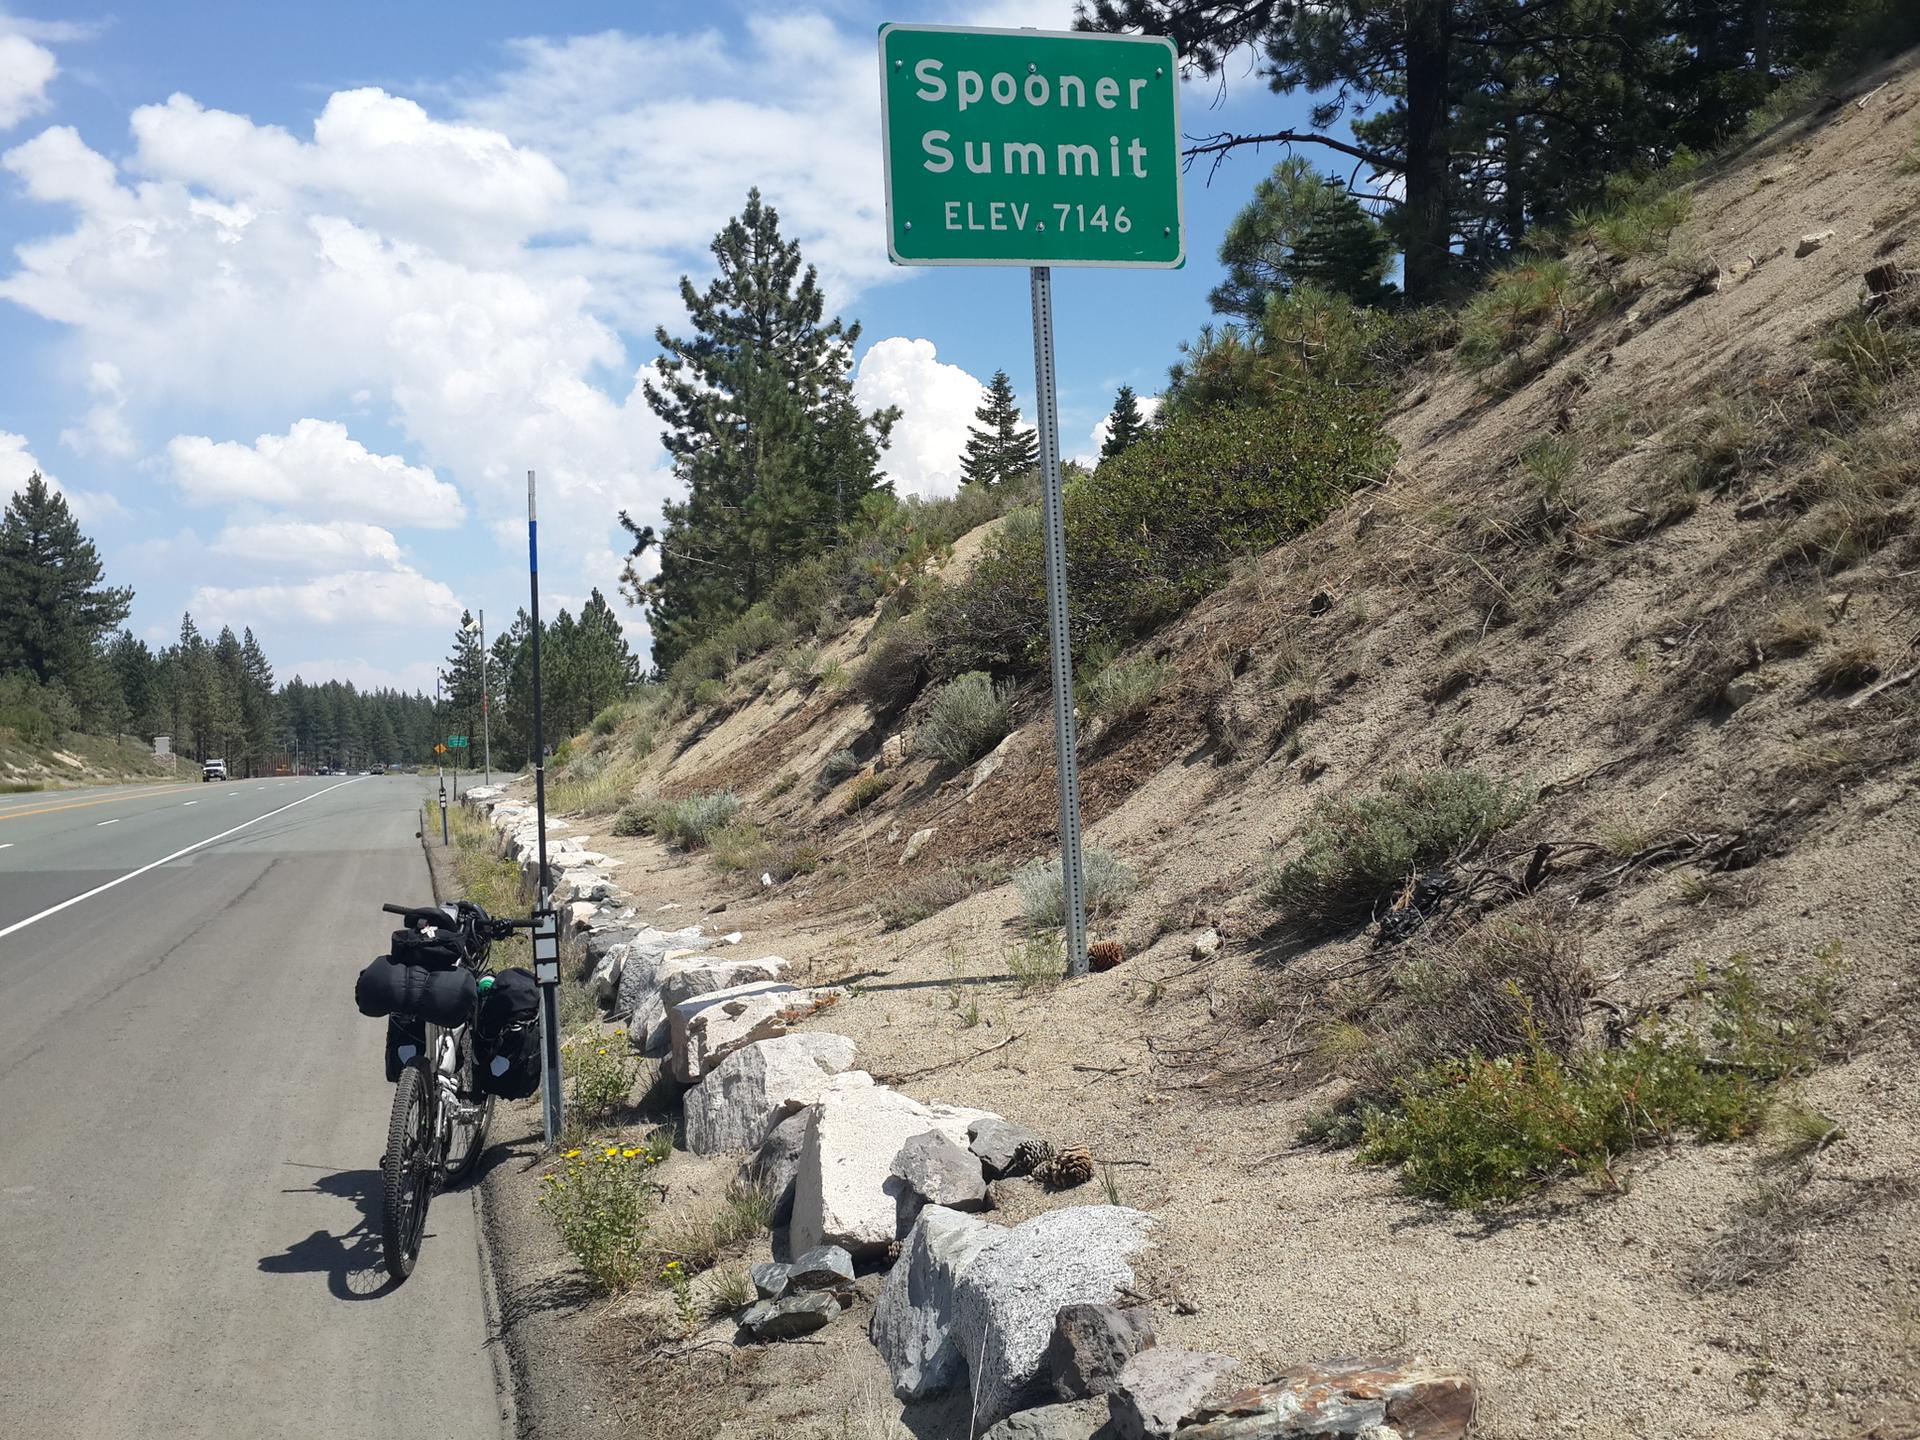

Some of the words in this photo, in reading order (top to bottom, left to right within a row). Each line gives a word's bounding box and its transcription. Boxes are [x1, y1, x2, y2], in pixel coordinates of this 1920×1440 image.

[914, 58, 1147, 111] Spooner
[921, 129, 1147, 178] Summit
[945, 201, 1030, 231] ELEV
[1053, 203, 1132, 234] 7146
